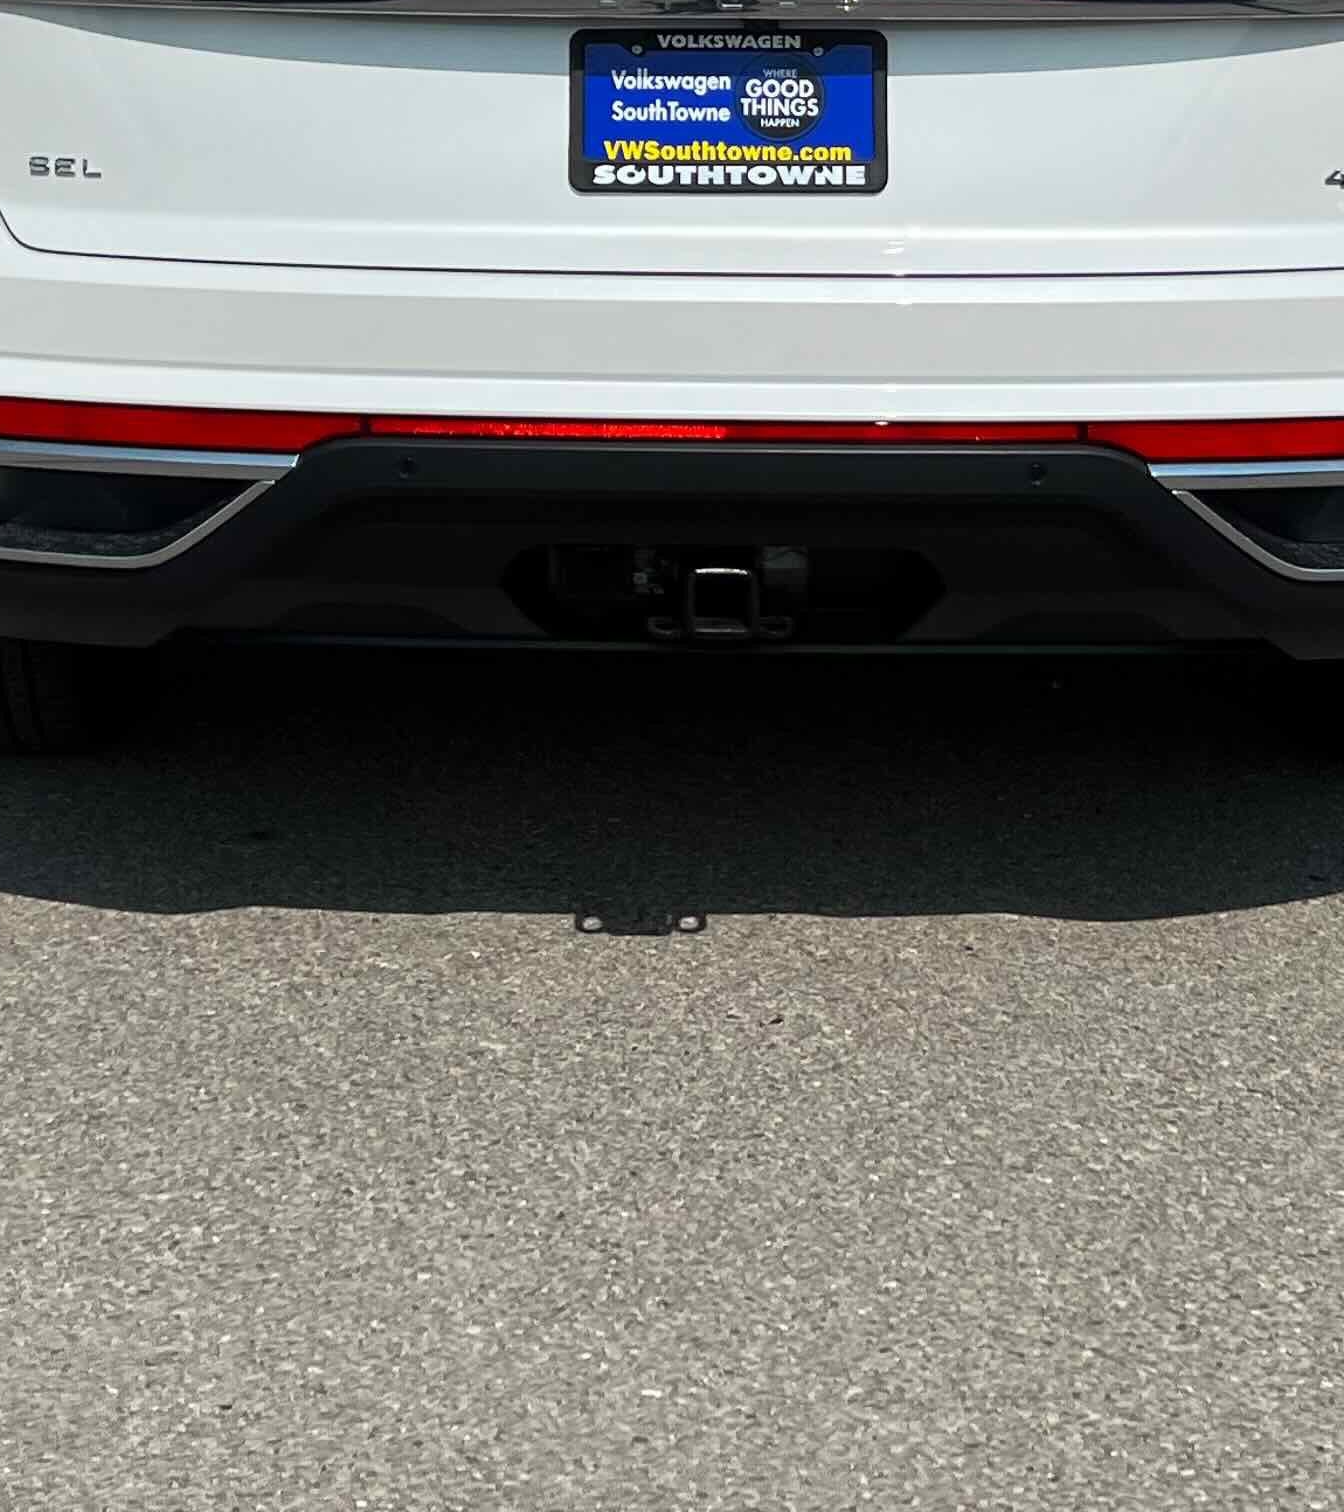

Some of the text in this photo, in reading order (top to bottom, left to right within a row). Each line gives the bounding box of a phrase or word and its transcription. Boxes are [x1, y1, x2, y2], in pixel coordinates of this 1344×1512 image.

[657, 34, 801, 49] VOLKSWAGEN
[611, 68, 732, 94] Volkswagen
[762, 68, 797, 79] WHERE
[745, 78, 815, 98] GOOD
[740, 98, 820, 117] THINGS
[760, 117, 800, 128] HAPPEN
[603, 140, 852, 162] VWSouthtowne.com
[29, 156, 102, 178] SEL
[592, 164, 866, 186] SOUTHTOWNE
